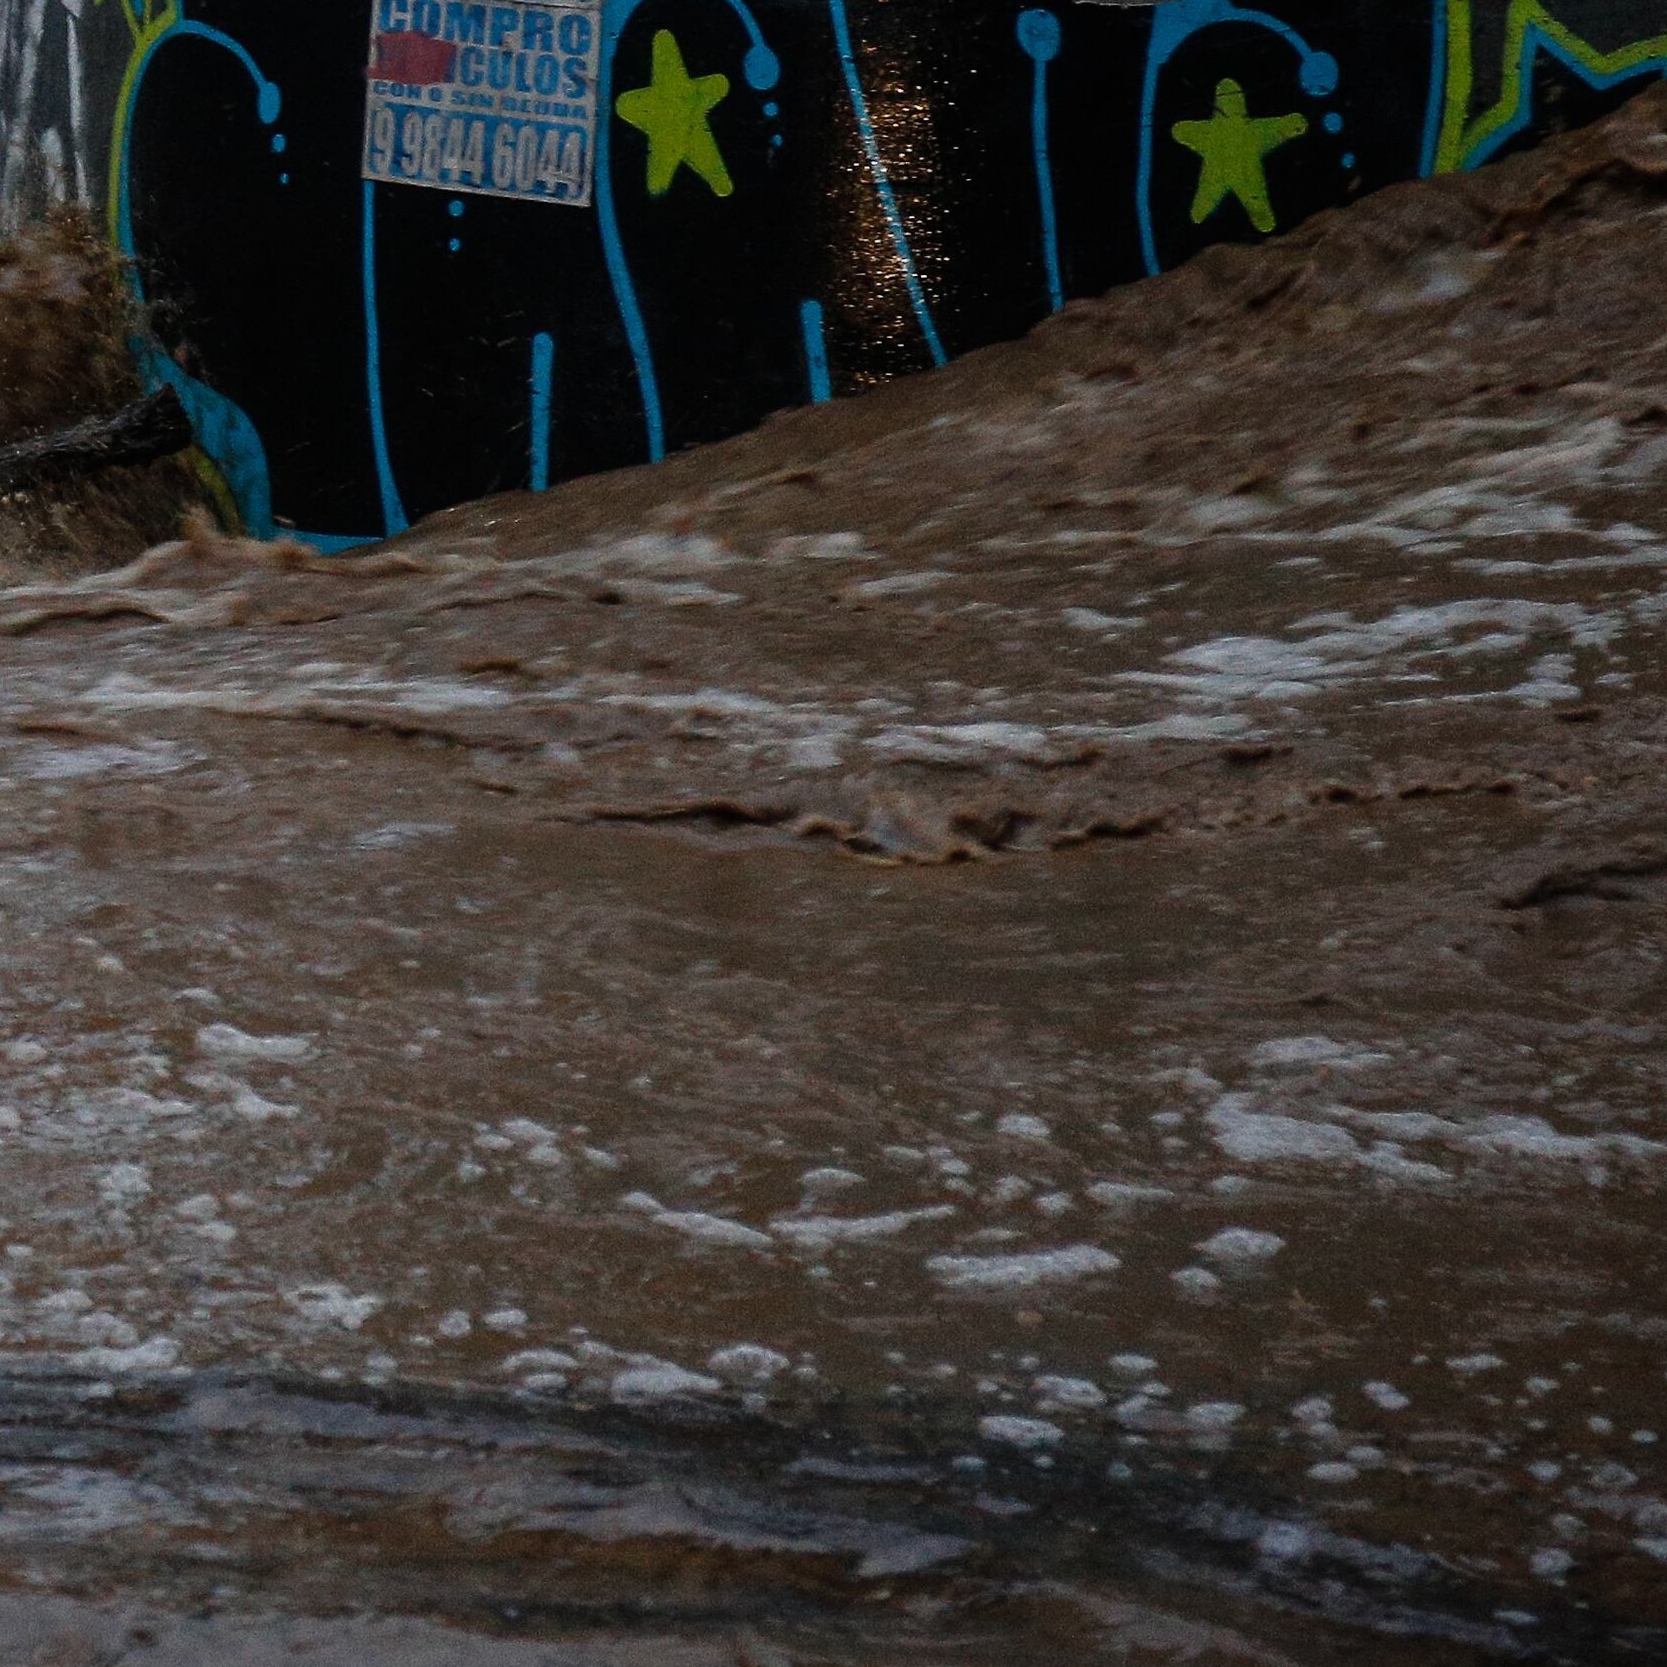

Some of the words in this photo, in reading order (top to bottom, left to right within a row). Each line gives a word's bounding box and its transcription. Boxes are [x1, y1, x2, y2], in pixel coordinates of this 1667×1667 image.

[373, 80, 422, 99] CON
[451, 90, 494, 107] SIN
[372, 106, 397, 174] 9
[400, 111, 485, 185] 9844
[491, 122, 582, 196] 6044
